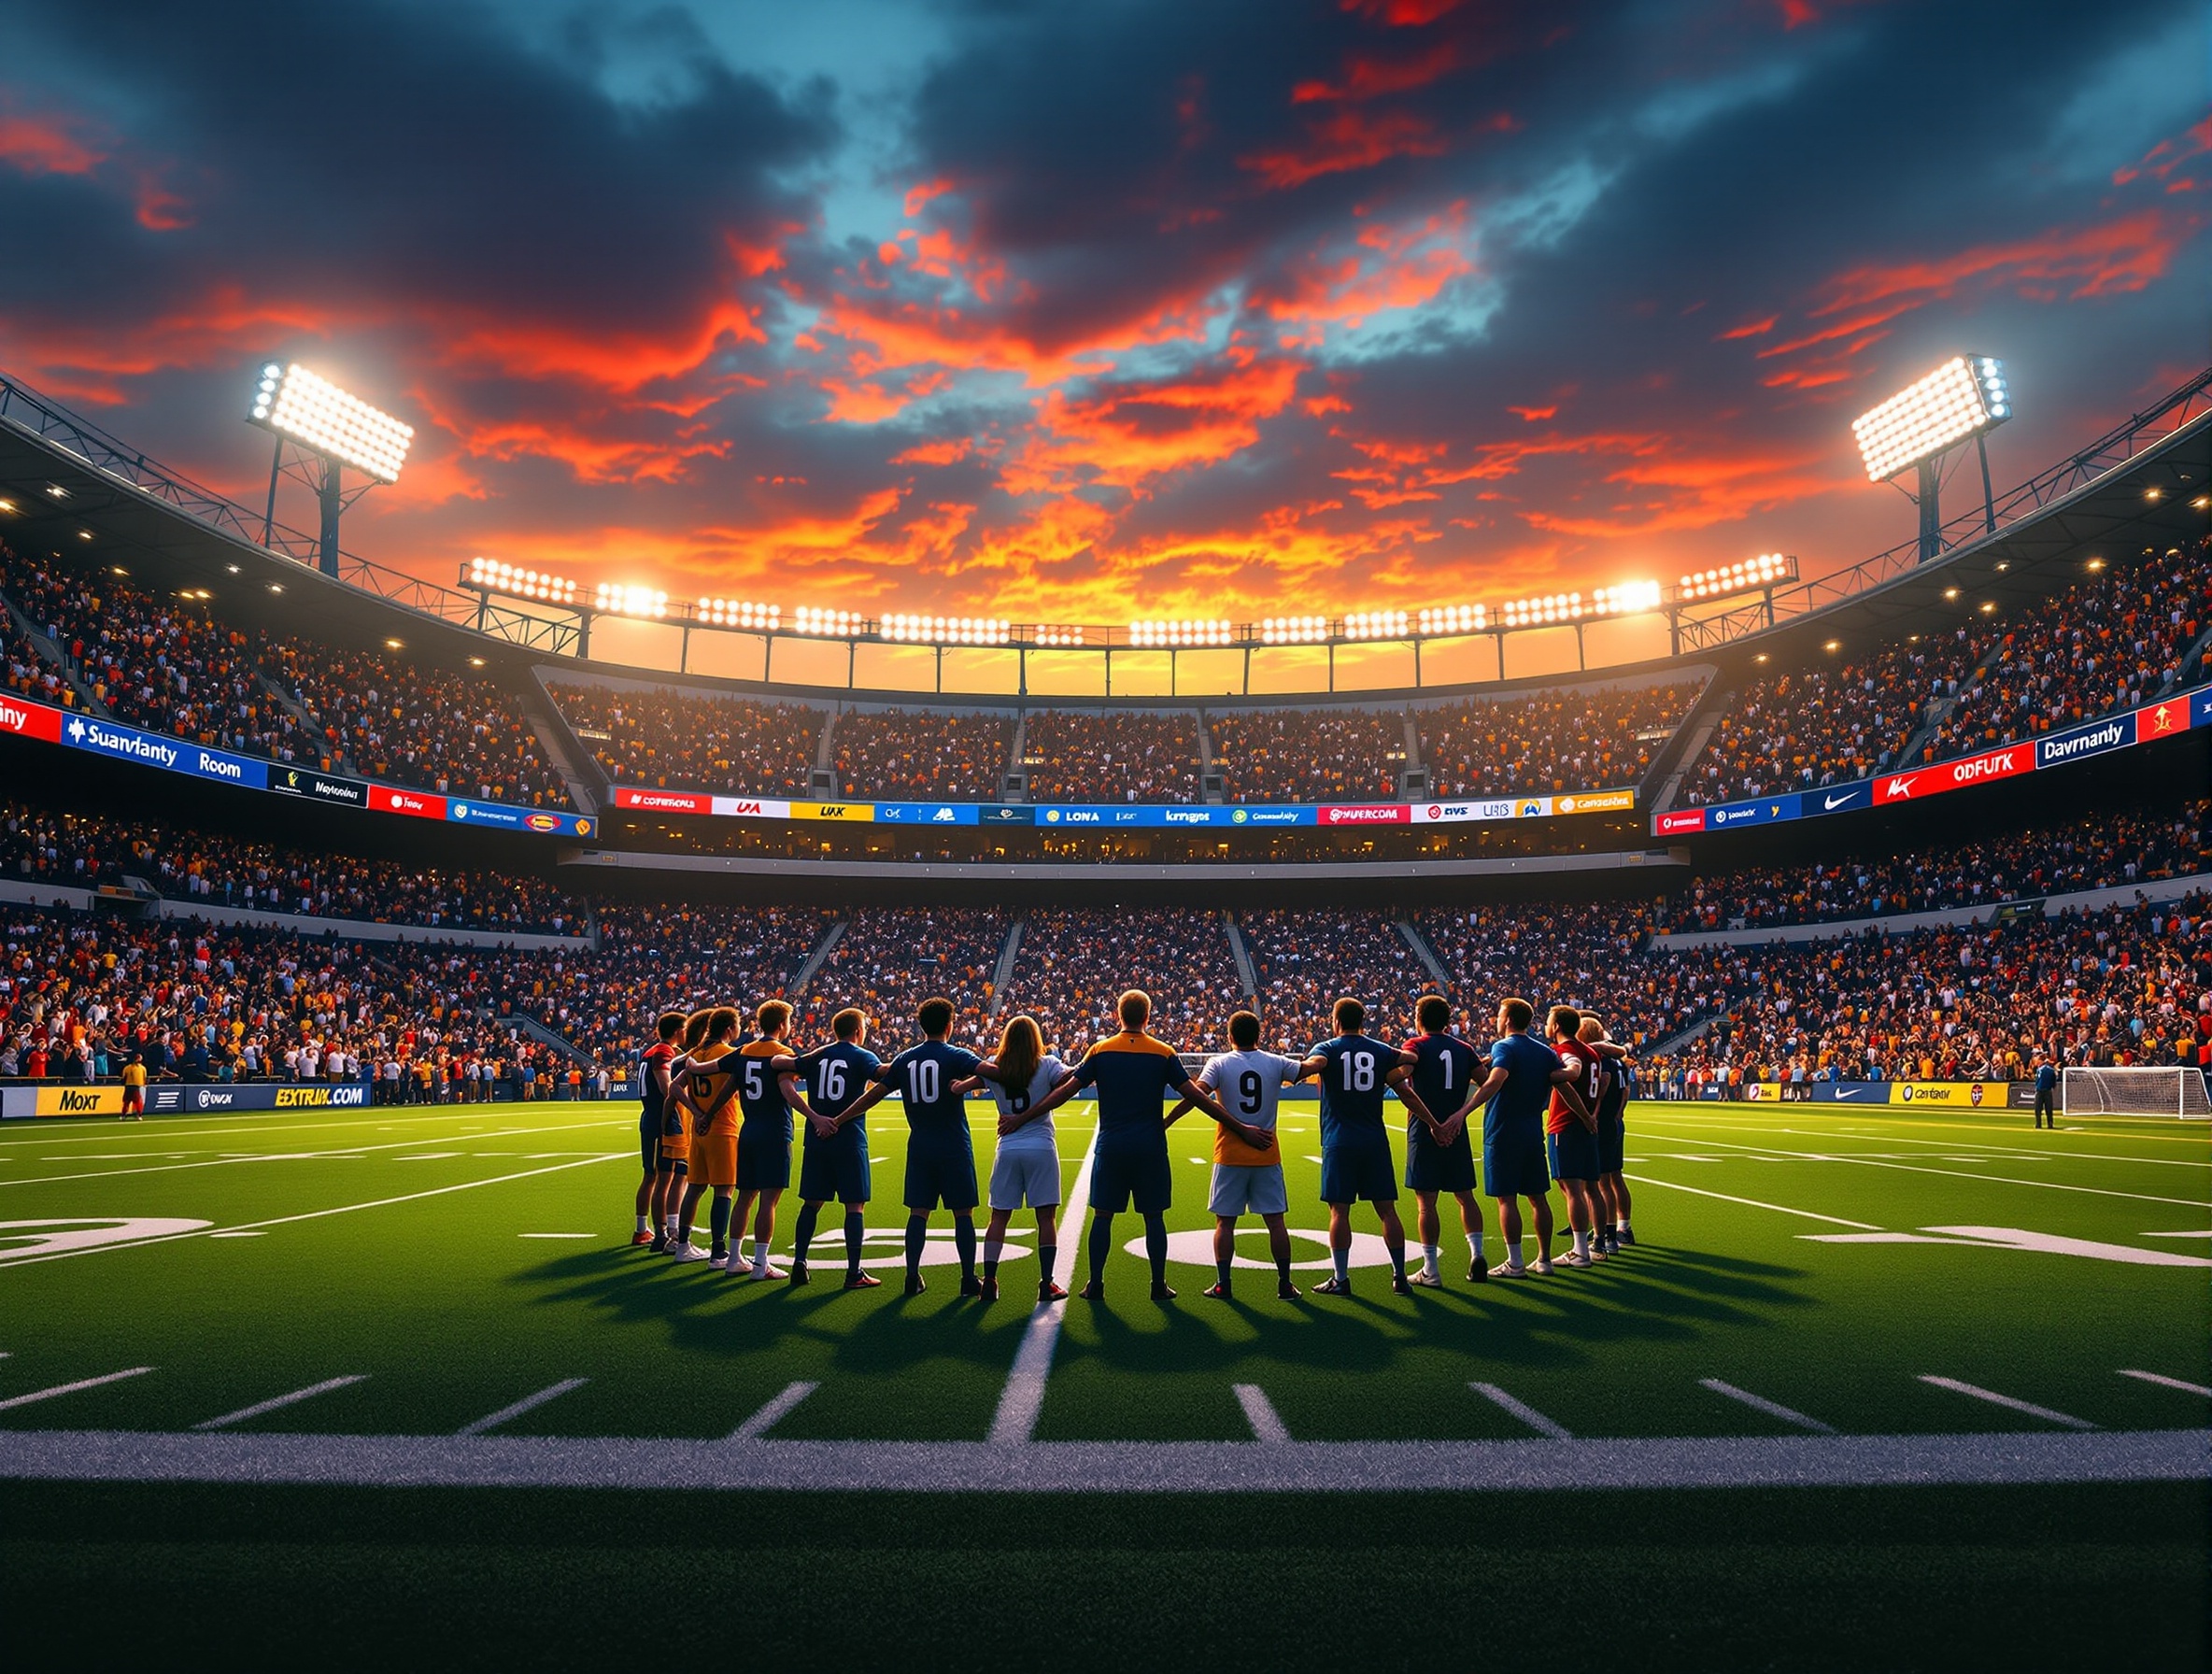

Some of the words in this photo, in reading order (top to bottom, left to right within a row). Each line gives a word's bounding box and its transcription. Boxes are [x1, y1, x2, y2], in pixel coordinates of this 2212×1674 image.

[199, 752, 241, 778] Room
[744, 1060, 763, 1100] 5
[816, 1057, 848, 1101] 16
[907, 1058, 940, 1104] 10
[1340, 1050, 1375, 1092] 18
[1439, 1049, 1453, 1090] 1
[1239, 1070, 1262, 1114] 9
